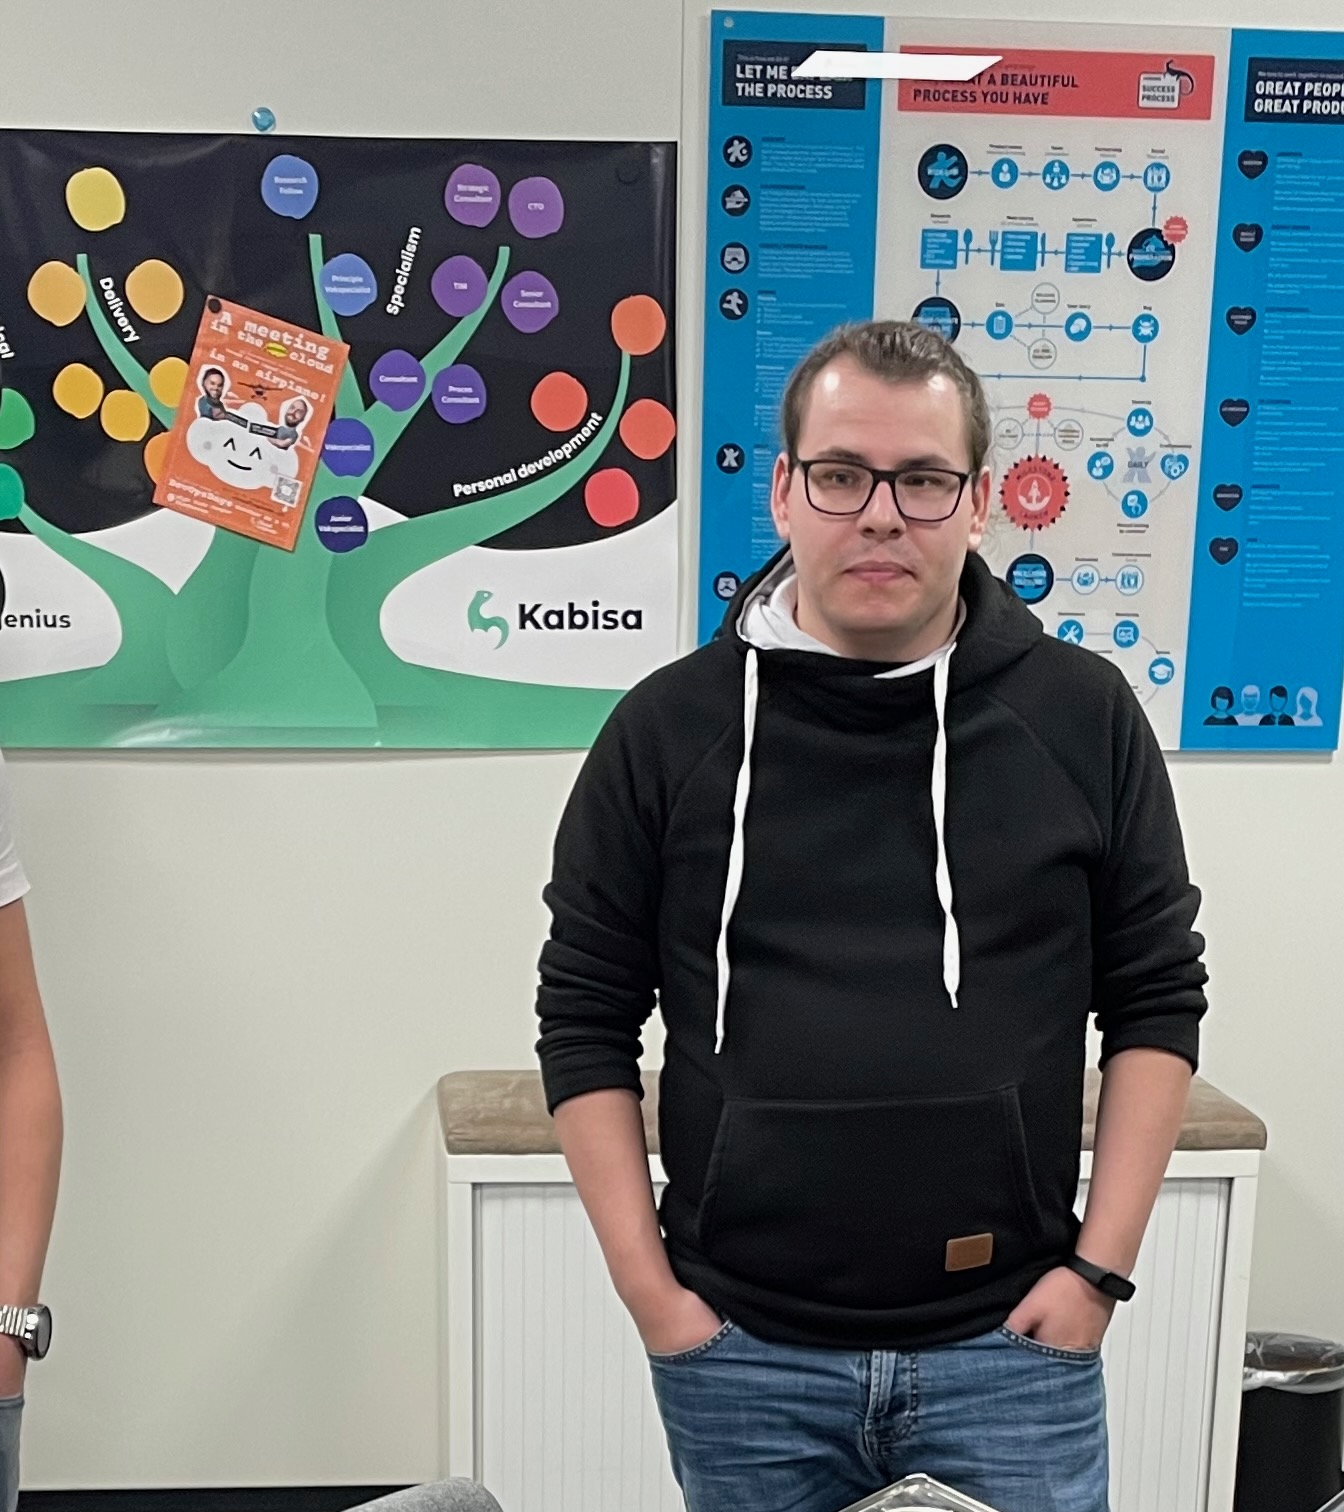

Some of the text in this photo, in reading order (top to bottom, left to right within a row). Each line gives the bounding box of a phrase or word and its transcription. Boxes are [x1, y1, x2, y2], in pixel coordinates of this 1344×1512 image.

[736, 64, 763, 78] LET
[766, 65, 788, 79] ME
[1001, 73, 1079, 88] BEAUTIFUL
[735, 82, 833, 99] THE PROCESS
[913, 88, 1050, 105] PROCESS YOU HAVE
[1256, 81, 1302, 95] GREAT
[1254, 98, 1301, 113] GREAT
[385, 225, 423, 316] Specialism
[99, 276, 141, 344] Delivery
[210, 319, 334, 374] in the cloud
[221, 311, 330, 360] A meeting
[209, 348, 326, 402] in an airplane!
[452, 411, 604, 498] Personal development
[518, 600, 643, 630] Kabisa
